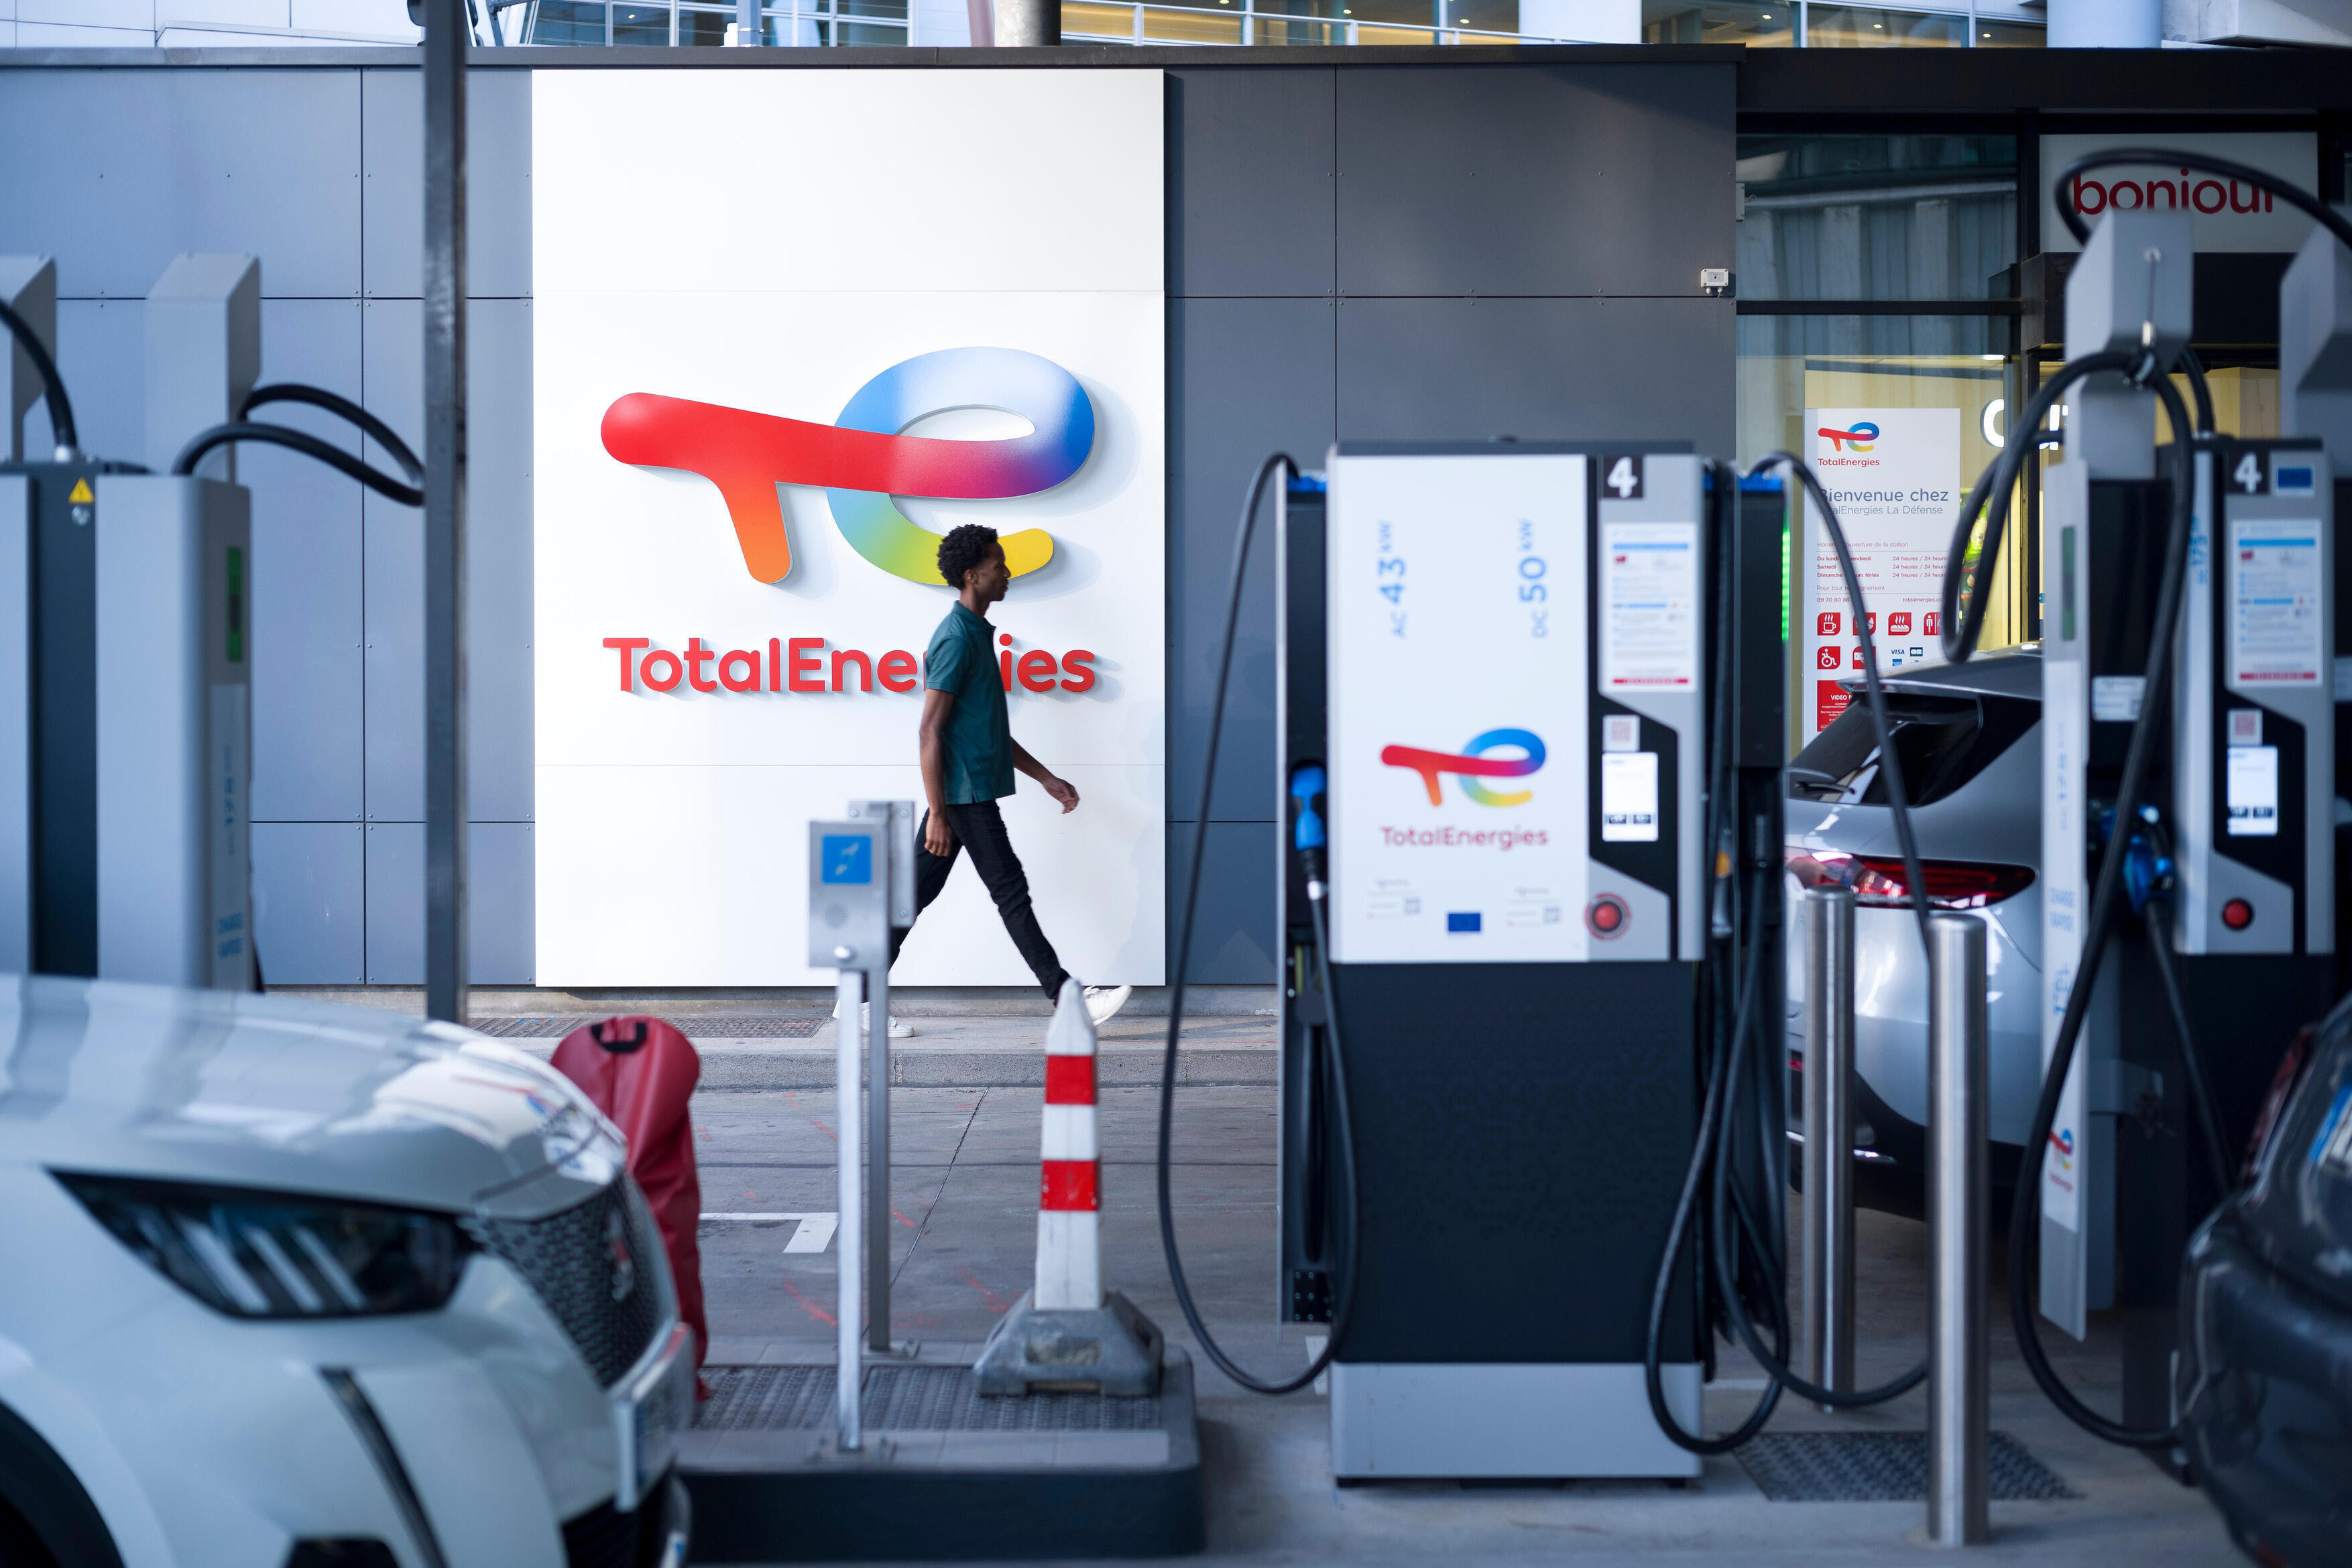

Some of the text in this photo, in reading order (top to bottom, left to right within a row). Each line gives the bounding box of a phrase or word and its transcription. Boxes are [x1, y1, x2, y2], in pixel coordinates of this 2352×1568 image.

[1607, 456, 1638, 498] 4
[1818, 458, 1880, 467] TotalEnergies
[2234, 453, 2262, 493] 4
[1820, 505, 1943, 516] alEnergies La Défense
[1909, 488, 1949, 501] chez
[1379, 559, 1405, 604] 43
[1519, 557, 1546, 601] 50
[602, 633, 1096, 693] TotalEneies
[1379, 825, 1549, 852] TotalEnergies
